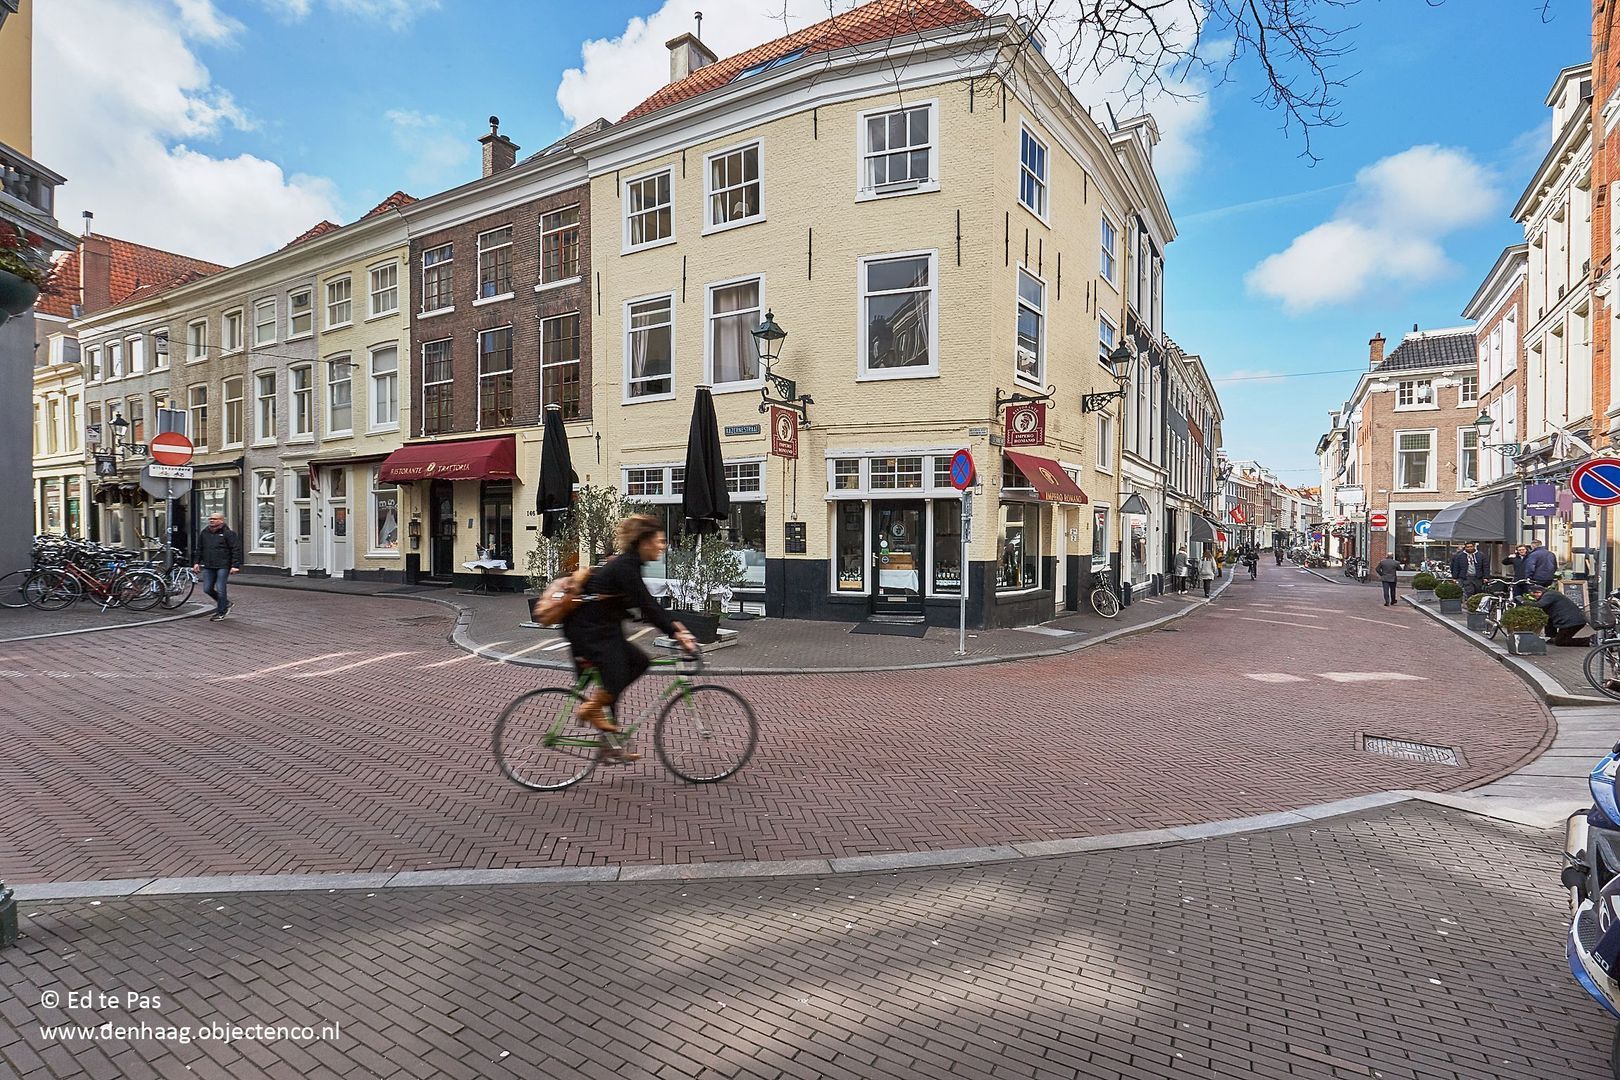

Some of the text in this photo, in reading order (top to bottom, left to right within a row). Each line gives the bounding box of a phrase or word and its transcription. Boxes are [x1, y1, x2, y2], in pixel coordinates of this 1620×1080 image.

[1012, 405, 1039, 415] RISTORANTE
[390, 463, 470, 475] RISTORANTE TRATTORIA
[1045, 491, 1082, 503] IMPERO ROMANO
